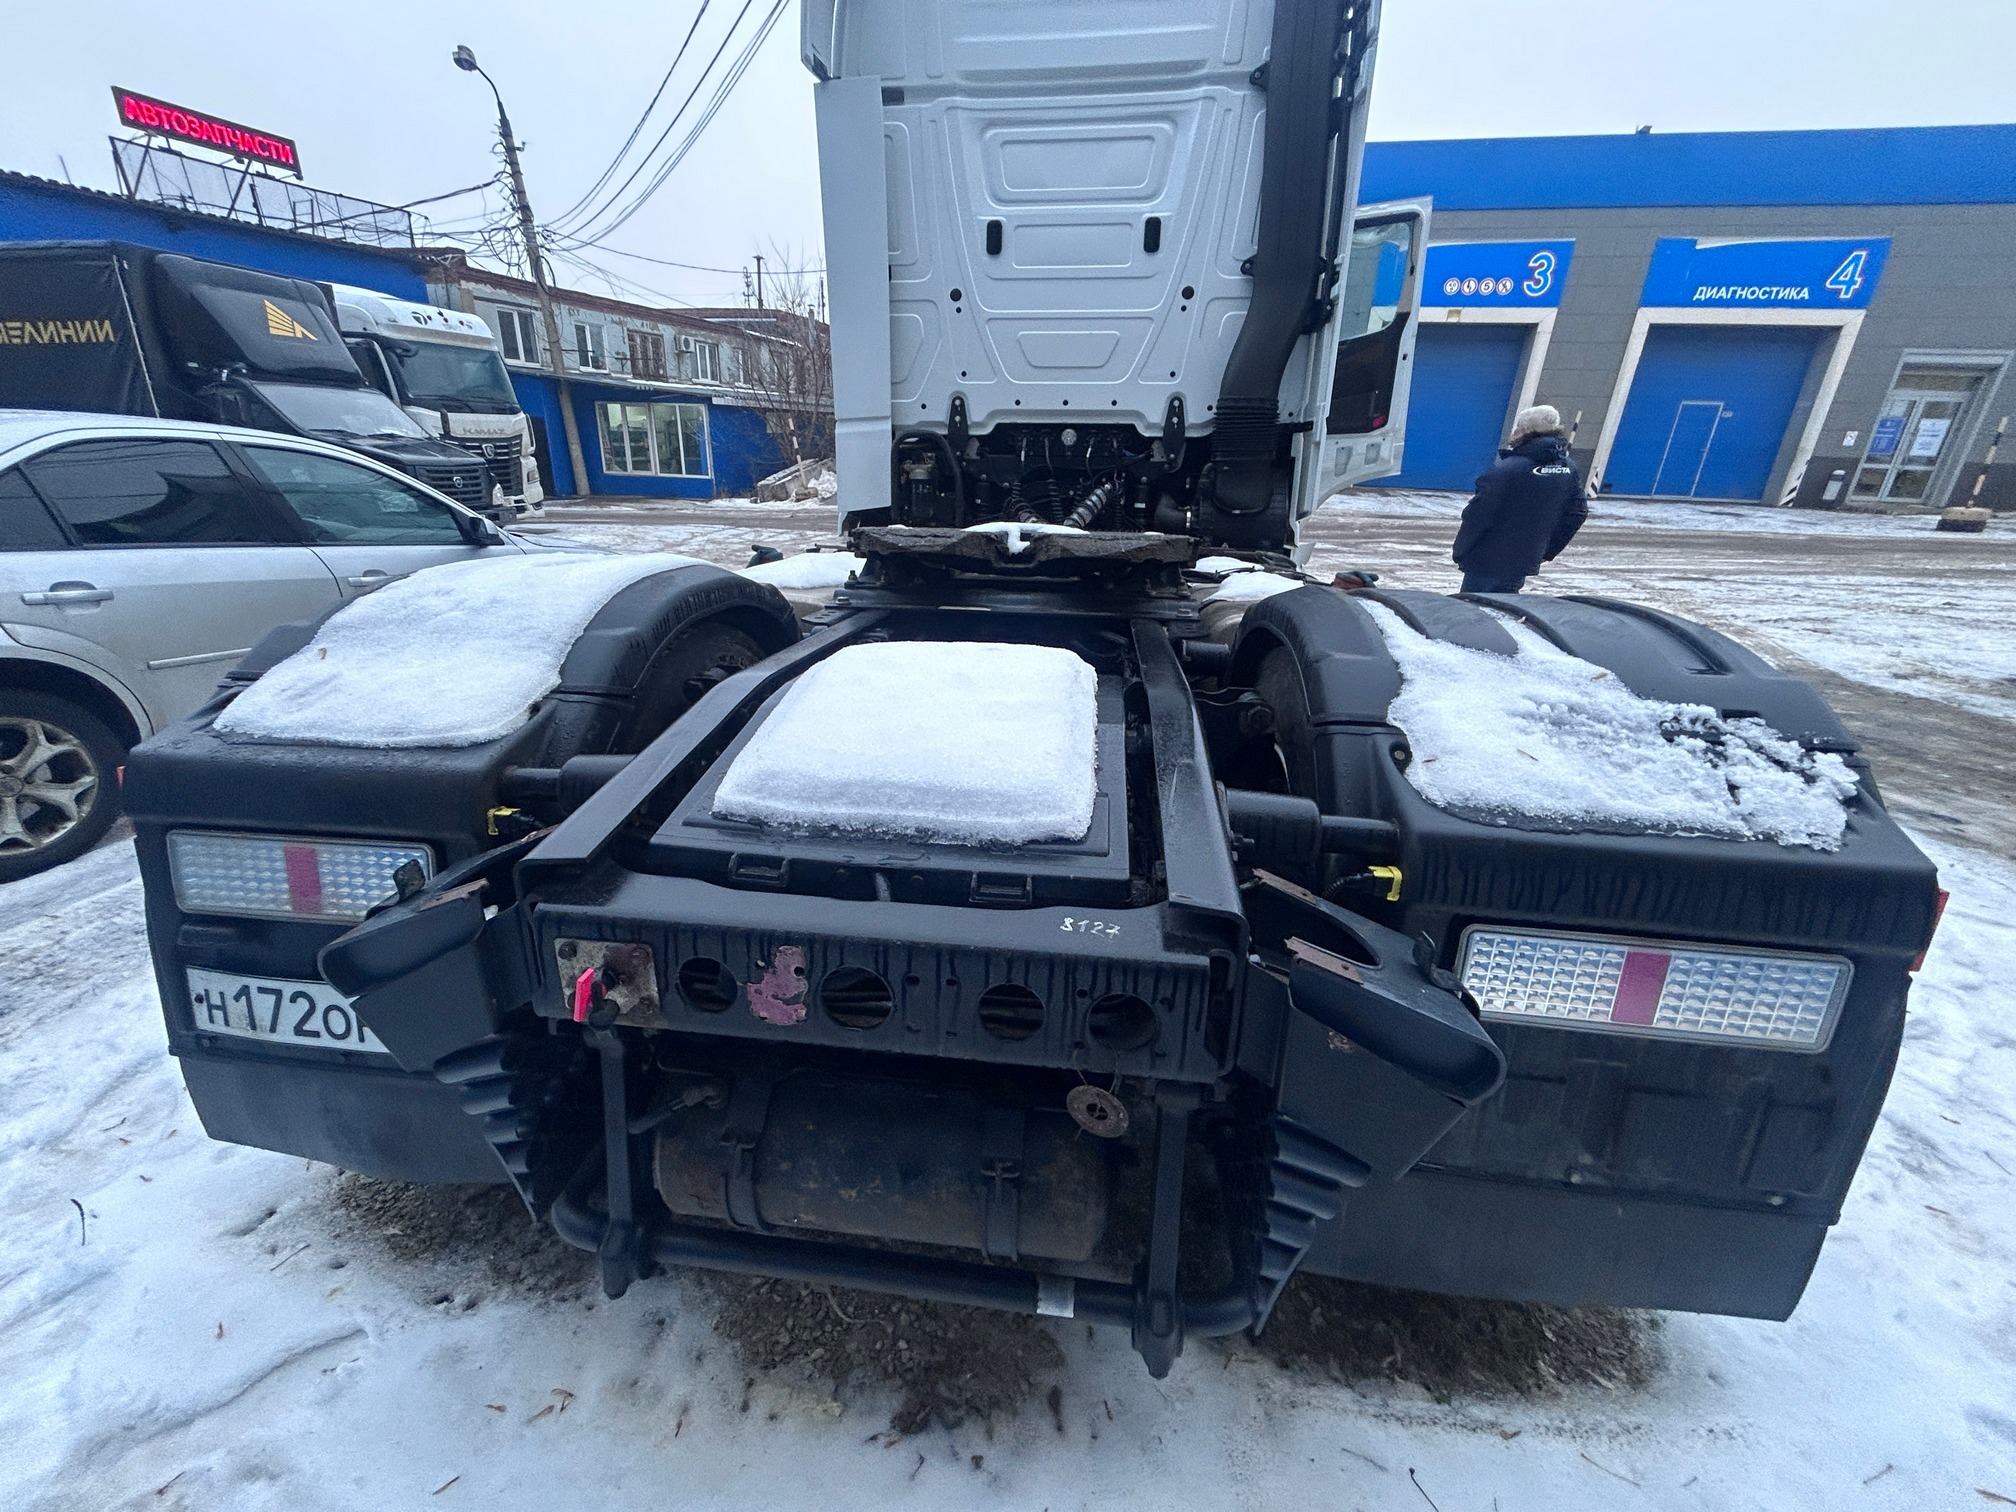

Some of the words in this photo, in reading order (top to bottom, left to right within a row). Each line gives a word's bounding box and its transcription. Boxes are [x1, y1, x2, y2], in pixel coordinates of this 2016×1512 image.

[124, 95, 295, 164] АВТОЗАПЧАСТИ
[1523, 251, 1556, 297] 3
[1693, 286, 1809, 301] ДИАГНОСТИКА
[1826, 251, 1868, 299] 4
